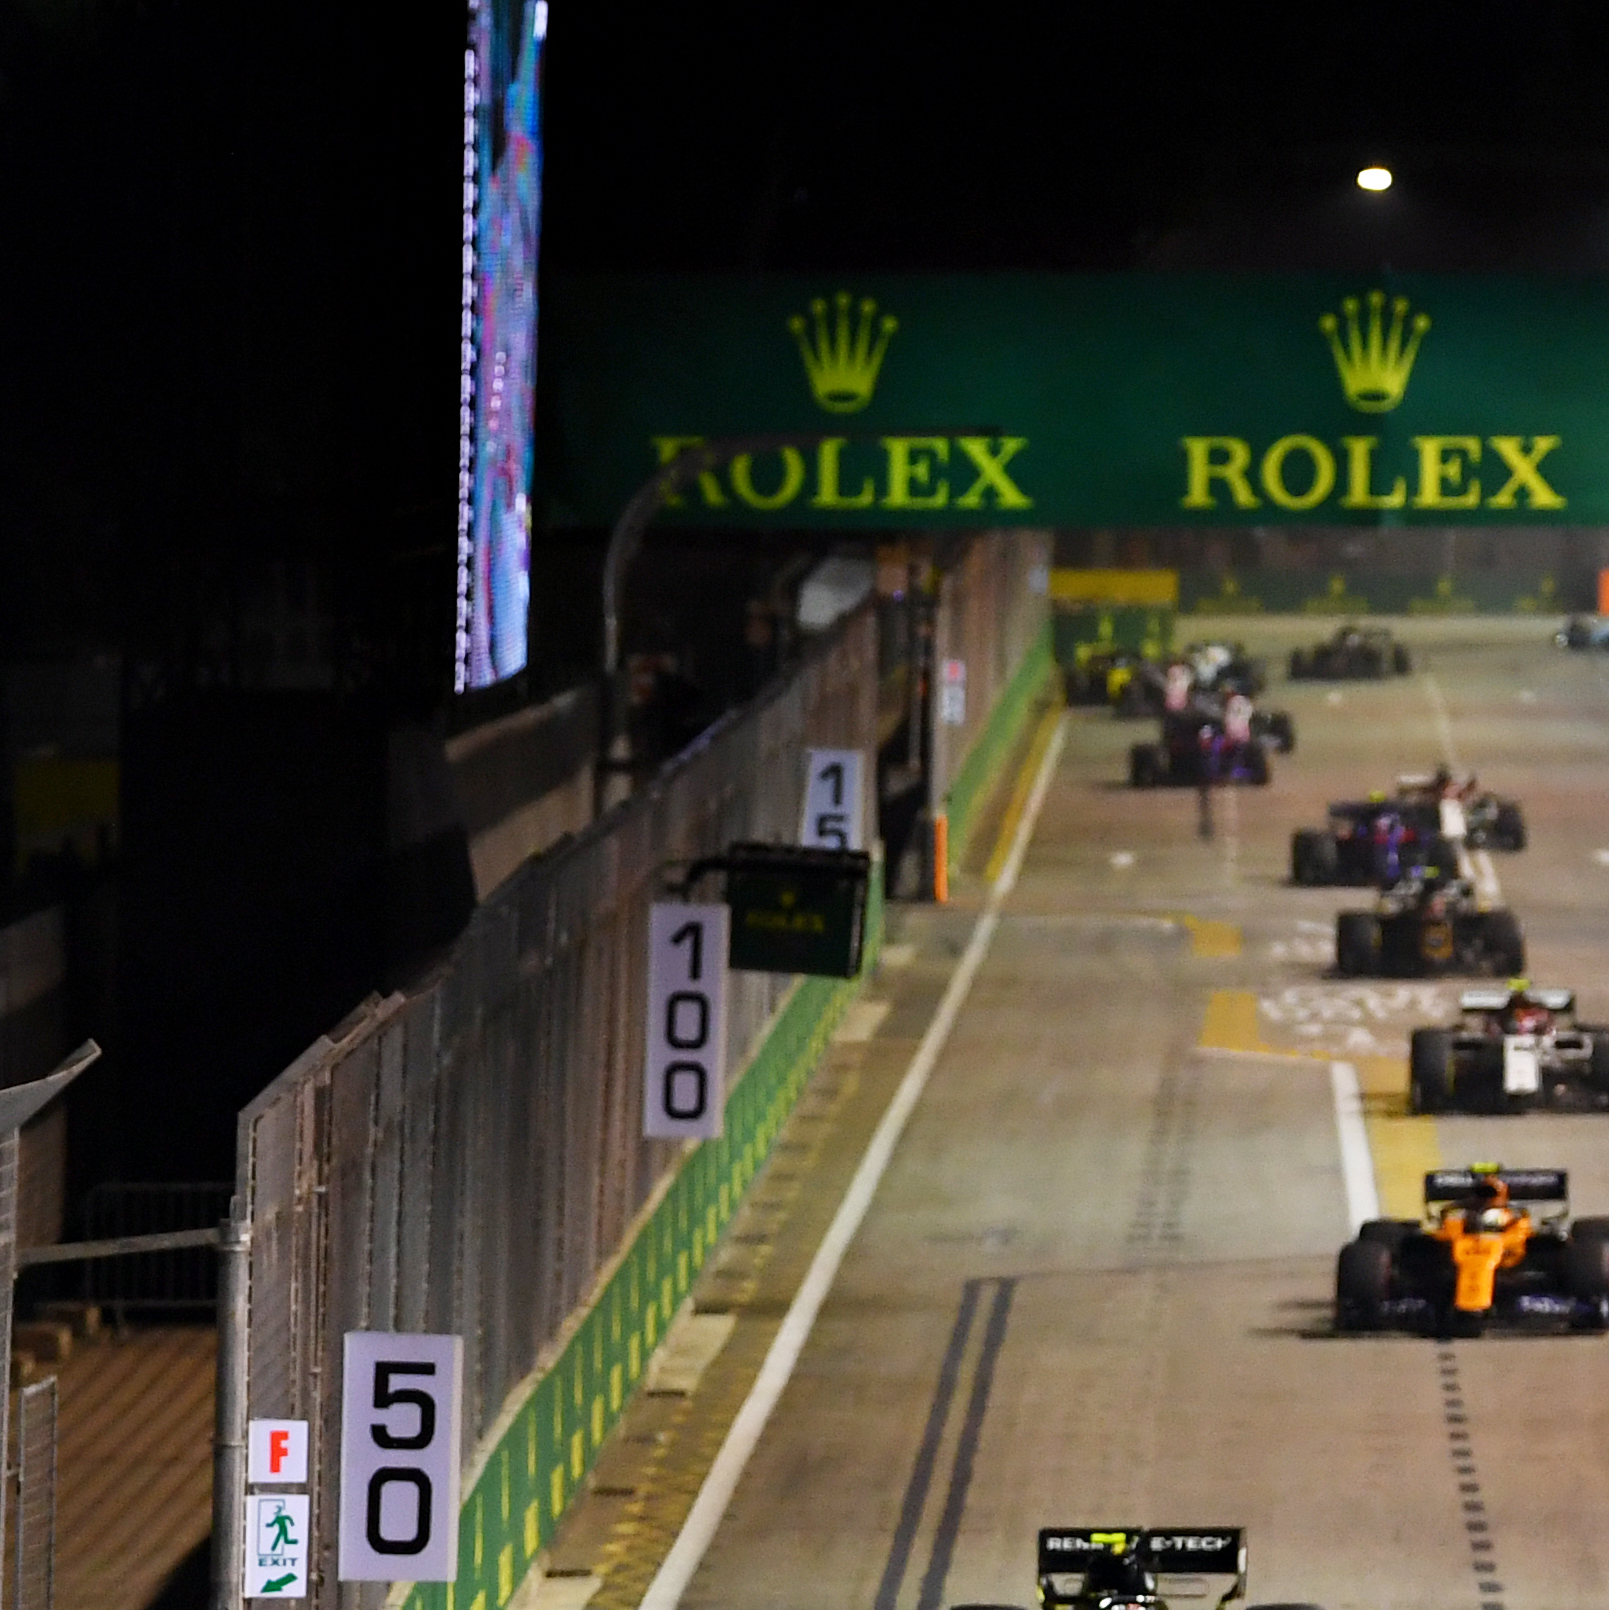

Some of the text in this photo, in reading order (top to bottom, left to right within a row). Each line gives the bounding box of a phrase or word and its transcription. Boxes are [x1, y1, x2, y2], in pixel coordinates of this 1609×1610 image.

[1181, 433, 1569, 511] ROLEX
[817, 762, 847, 848] 15
[662, 920, 710, 1121] 100
[269, 1430, 289, 1473] F
[367, 1362, 435, 1555] 50
[258, 1557, 298, 1567] EXIT
